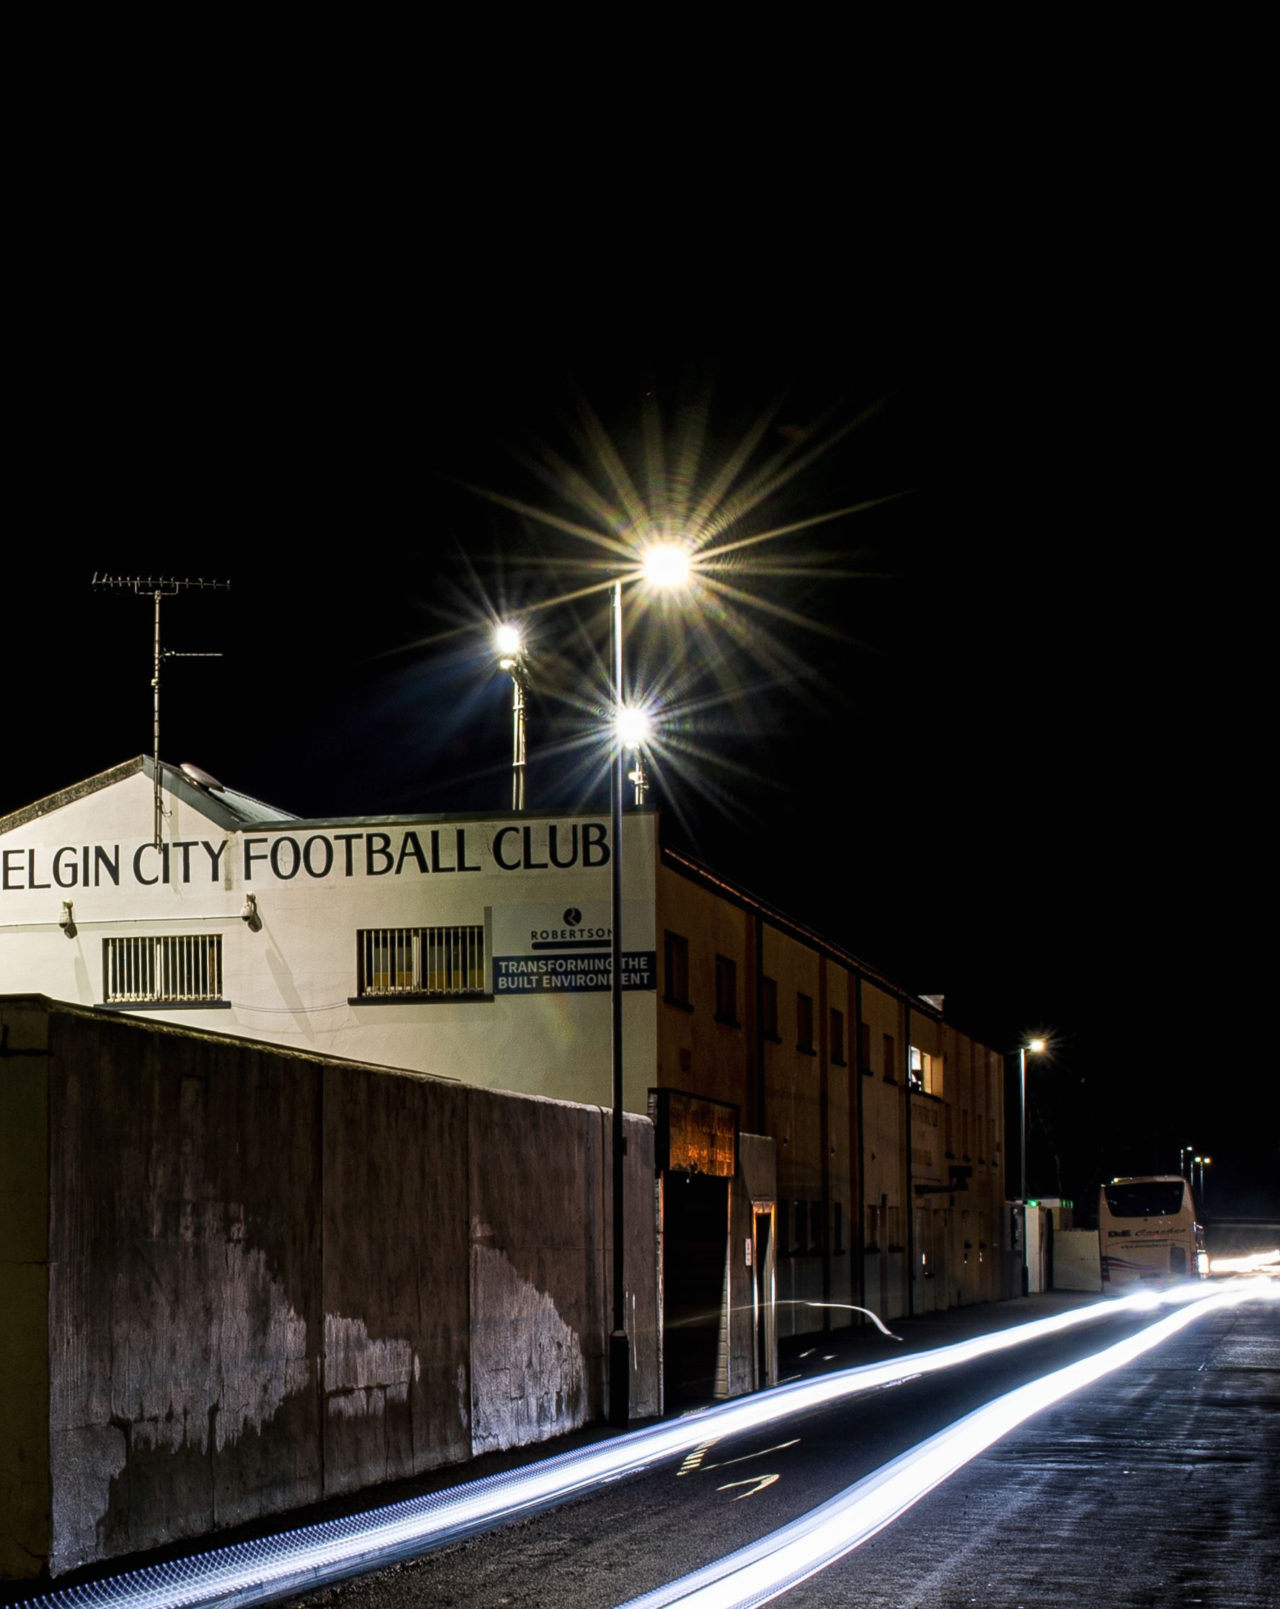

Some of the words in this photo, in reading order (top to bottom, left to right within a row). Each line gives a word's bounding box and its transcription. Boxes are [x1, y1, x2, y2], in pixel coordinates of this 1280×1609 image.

[1, 843, 120, 891] ELGIN
[132, 839, 230, 885] CITY
[243, 828, 482, 881] FOOTBALL
[492, 822, 612, 871] CLUB
[620, 956, 648, 969] THE
[498, 975, 538, 990] BUILT
[541, 972, 651, 988] ENVIRONENT
